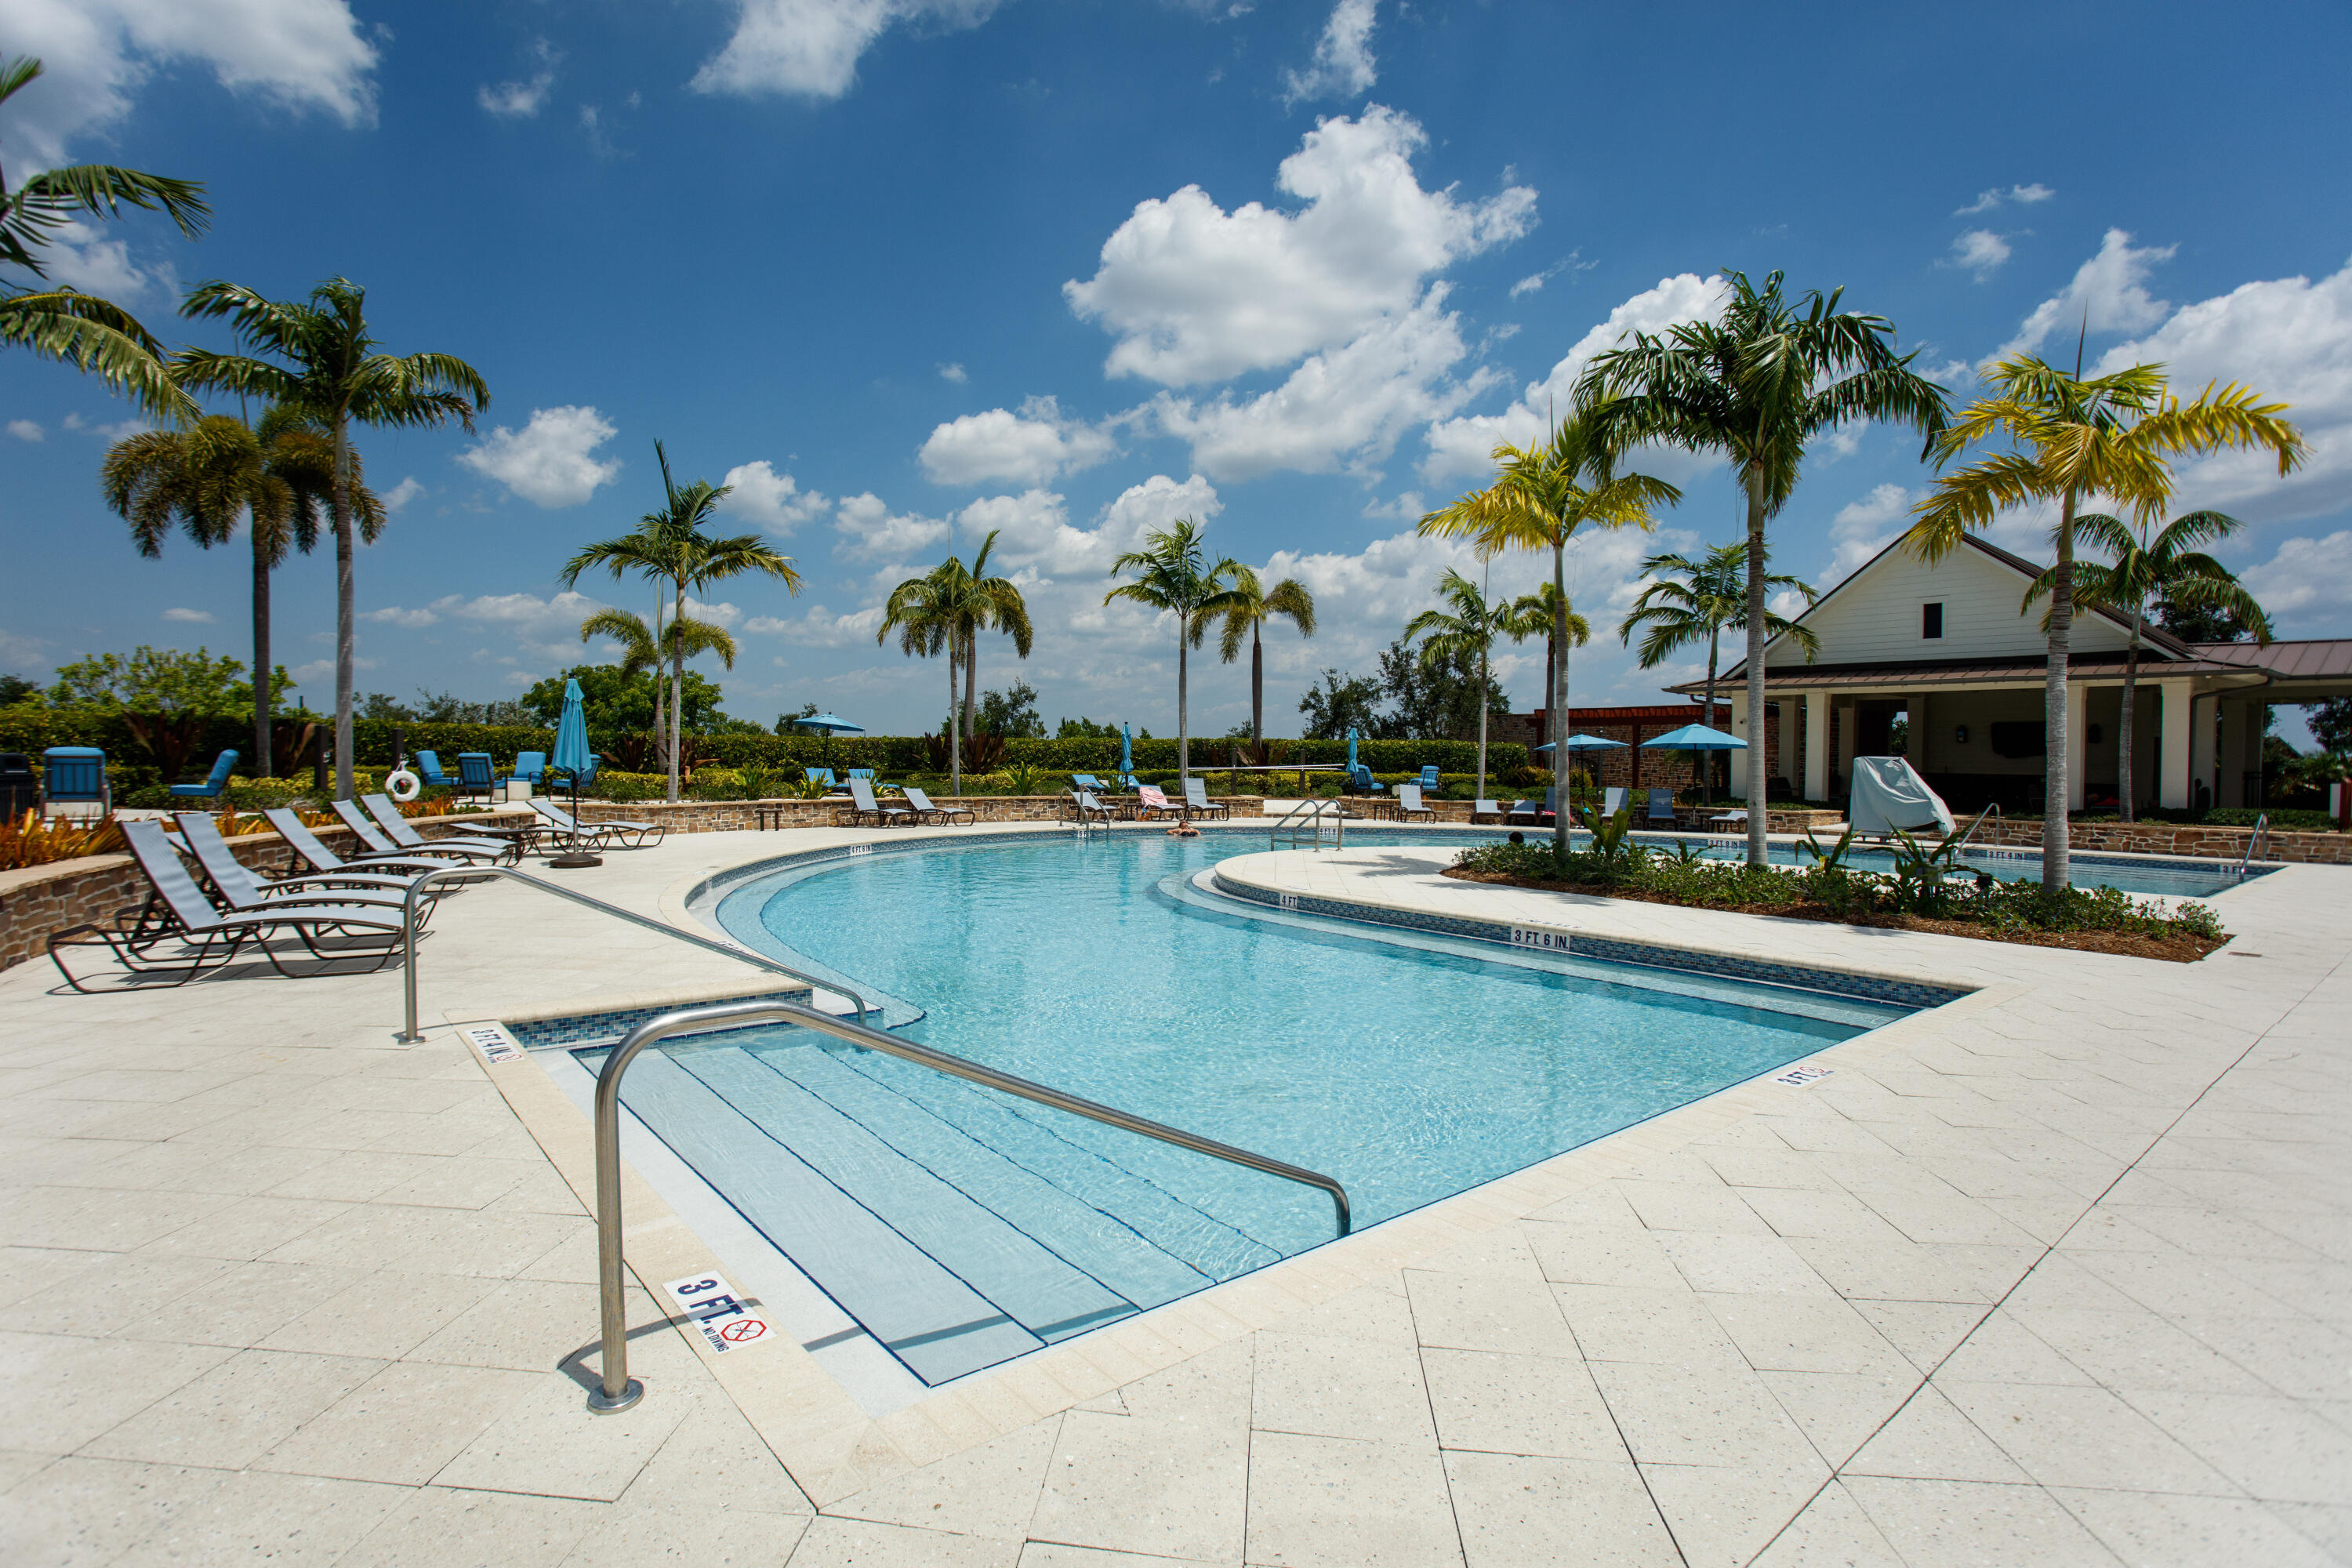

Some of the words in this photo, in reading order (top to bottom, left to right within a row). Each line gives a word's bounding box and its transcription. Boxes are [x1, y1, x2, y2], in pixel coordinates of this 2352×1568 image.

[1282, 895, 1286, 906] 4
[1515, 930, 1521, 941] 3
[1544, 934, 1551, 946] 6
[677, 1279, 718, 1295] 3
[689, 1294, 746, 1324] FT.
[702, 1327, 716, 1335] NO
[708, 1334, 729, 1352] DIVING
